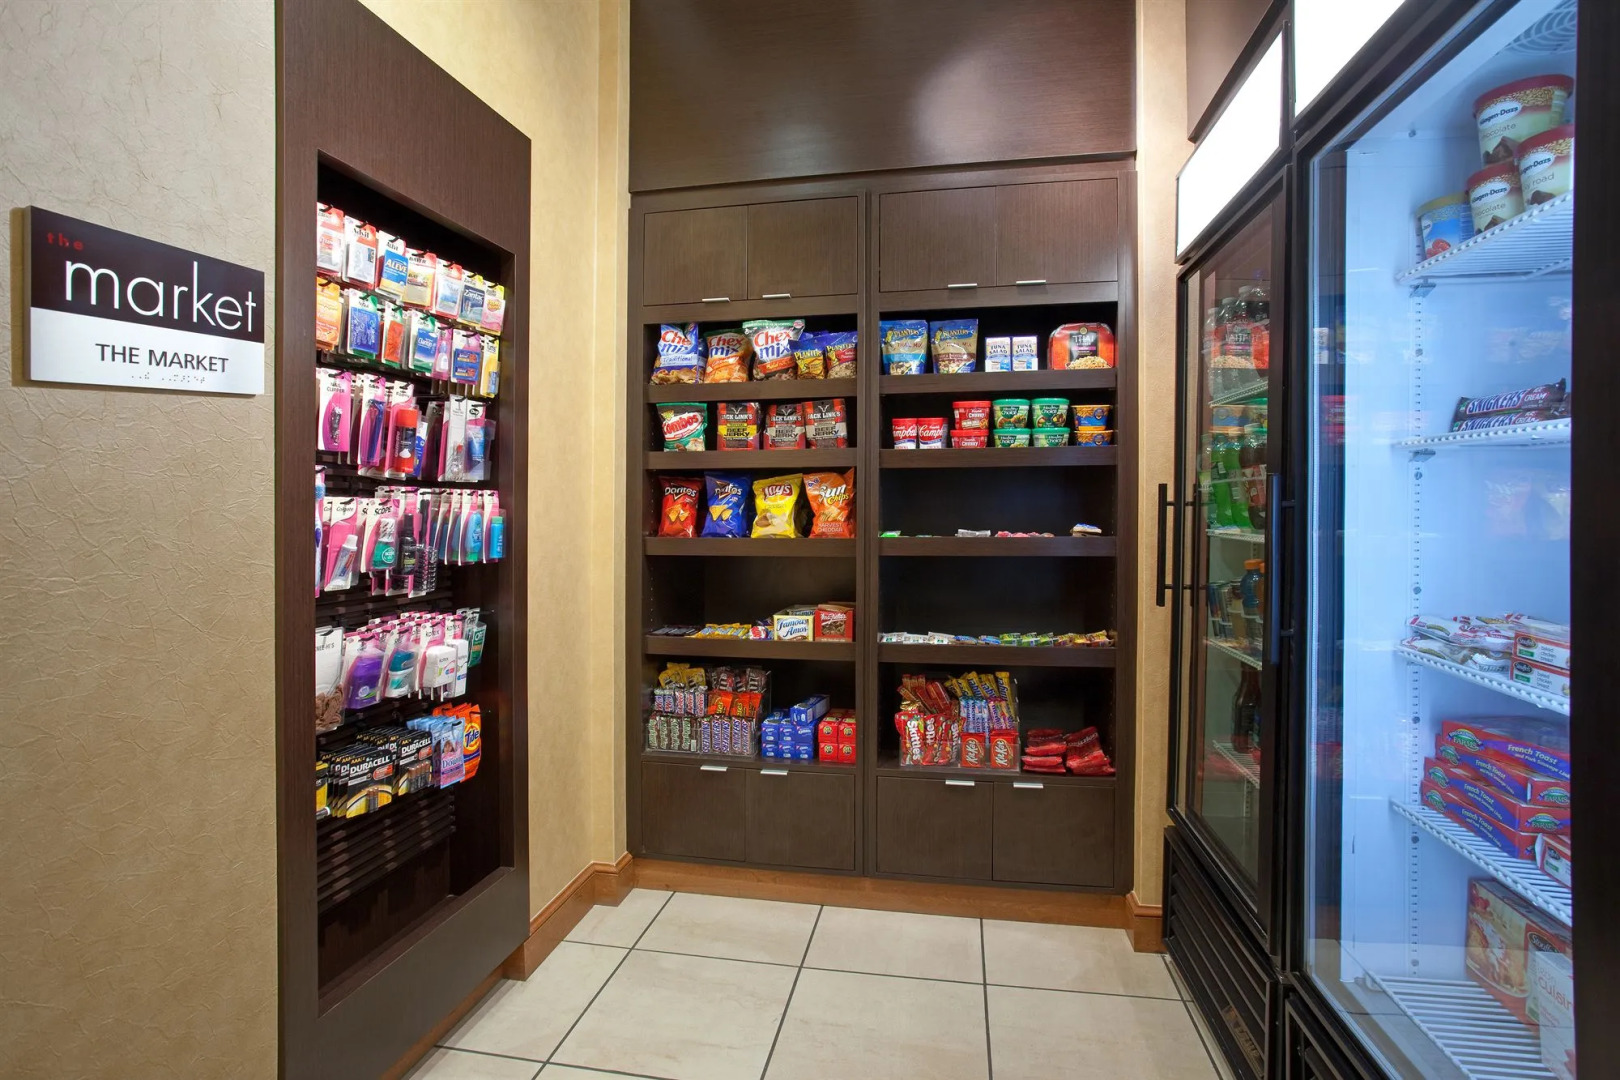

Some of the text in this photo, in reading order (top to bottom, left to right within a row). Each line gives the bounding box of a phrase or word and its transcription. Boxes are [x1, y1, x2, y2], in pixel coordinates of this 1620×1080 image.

[1532, 172, 1555, 187] road
[47, 232, 84, 250] the
[385, 259, 407, 273] ALEVE
[65, 260, 257, 332] market
[464, 289, 484, 302] Zantac
[709, 335, 743, 348] Chex
[753, 331, 792, 347] Chex
[95, 343, 229, 373] THE MARKET
[710, 346, 739, 358] mix
[759, 342, 791, 359] mix
[663, 355, 693, 363] Traditional
[1467, 389, 1527, 412] SNICKERS
[1523, 392, 1547, 402] CREAM
[662, 414, 698, 435] Combos
[812, 429, 839, 437] JERKY
[665, 486, 697, 497] Doritos
[715, 483, 743, 496] Doritos
[819, 484, 847, 500] Sun
[827, 494, 849, 505] Chips
[374, 505, 393, 515] SCOPE
[778, 619, 808, 631] Famous
[783, 626, 808, 638] Amos
[401, 737, 432, 754] DURACELL
[464, 729, 480, 748] Tide
[906, 720, 921, 761] Skittles
[1507, 744, 1558, 765] French Toast
[349, 755, 391, 774] DURACELL
[1475, 759, 1506, 780] French Toast
[1525, 755, 1537, 763] Pork
[1537, 759, 1559, 772] Sausage
[1464, 783, 1494, 804] French Toast
[1461, 808, 1493, 831] French Toast
